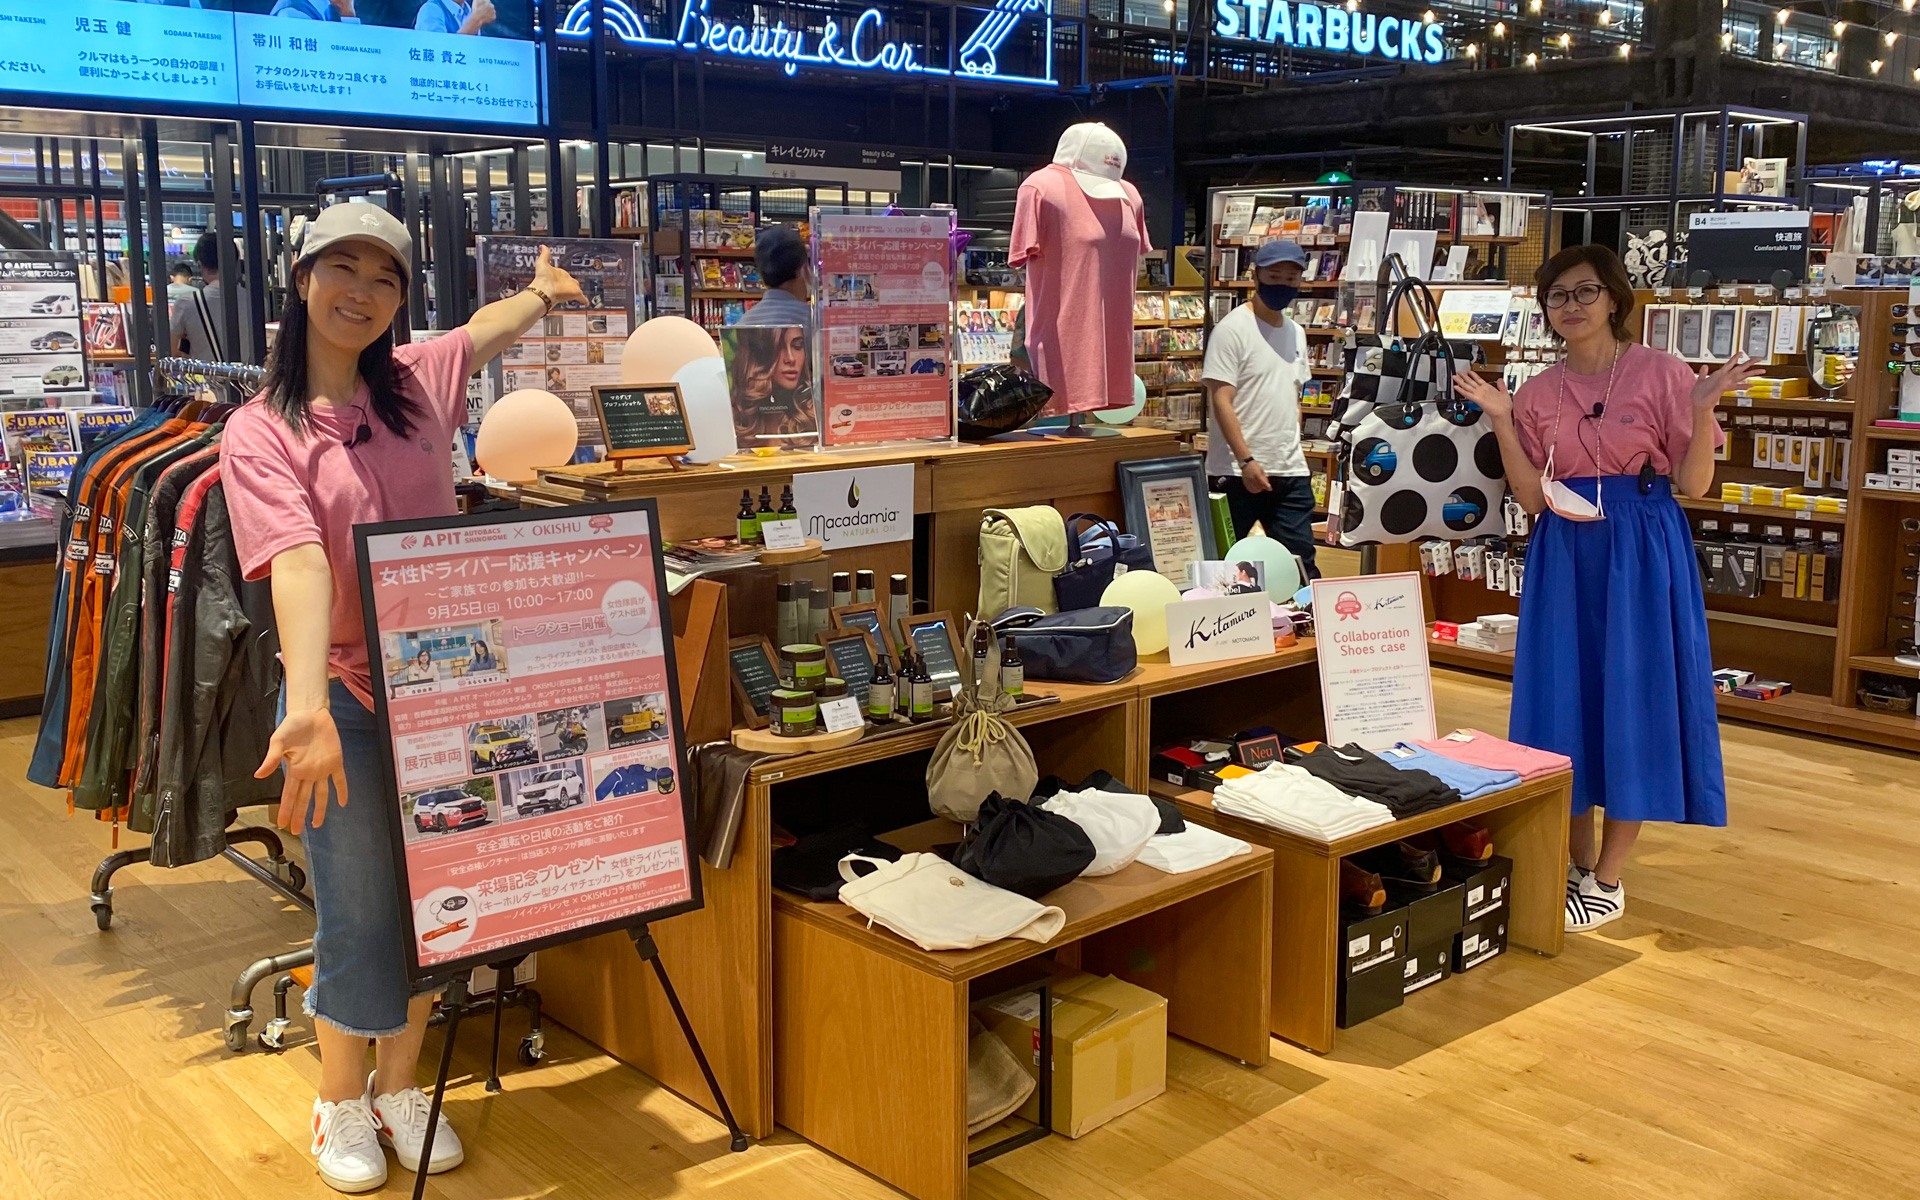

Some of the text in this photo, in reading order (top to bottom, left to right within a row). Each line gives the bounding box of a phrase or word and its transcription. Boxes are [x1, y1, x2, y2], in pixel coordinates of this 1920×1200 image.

[14, 15, 46, 25] TAKESHI
[75, 16, 132, 36] 児玉 健
[163, 29, 222, 41] KODAMA TAKESHI
[678, 0, 803, 76] Beauty
[851, 8, 918, 71] Car
[1216, 0, 1444, 64] STARBUCKS
[252, 33, 318, 52] 帯川 和樹
[330, 43, 382, 54] OBIKAWA KAZUKI
[408, 46, 468, 65] 佐藤 貴之
[254, 64, 388, 85] アナタのクルマをカッコ良くする
[770, 144, 827, 159] キレイとクルマ
[861, 149, 880, 159] Beauty
[886, 150, 896, 159] Car
[1694, 217, 1707, 226] B4
[1774, 231, 1803, 242] 快適旅
[1753, 244, 1788, 252] Comfortable
[7, 414, 66, 428] SUBARU
[79, 413, 133, 426] SUBARU
[28, 455, 78, 467] SUBAR
[464, 527, 501, 536] AUTOBACS
[532, 521, 581, 537] OKISHU
[807, 508, 896, 542] Macadamia
[842, 525, 897, 538] NATURAL OIL
[379, 543, 643, 587] 女性ドライバー応援キャンペーン
[513, 615, 607, 640] トークショー開催
[1184, 607, 1257, 648] Kitamura
[1333, 627, 1410, 643] Collaboration
[1340, 642, 1406, 657] Shoes case
[404, 747, 462, 772] 展示車両
[1250, 746, 1273, 760] Neu
[476, 813, 624, 855] 安全運転や日頃の活動をご紹介
[477, 846, 679, 898] 来場記念プレゼント 女性ドライバーに
